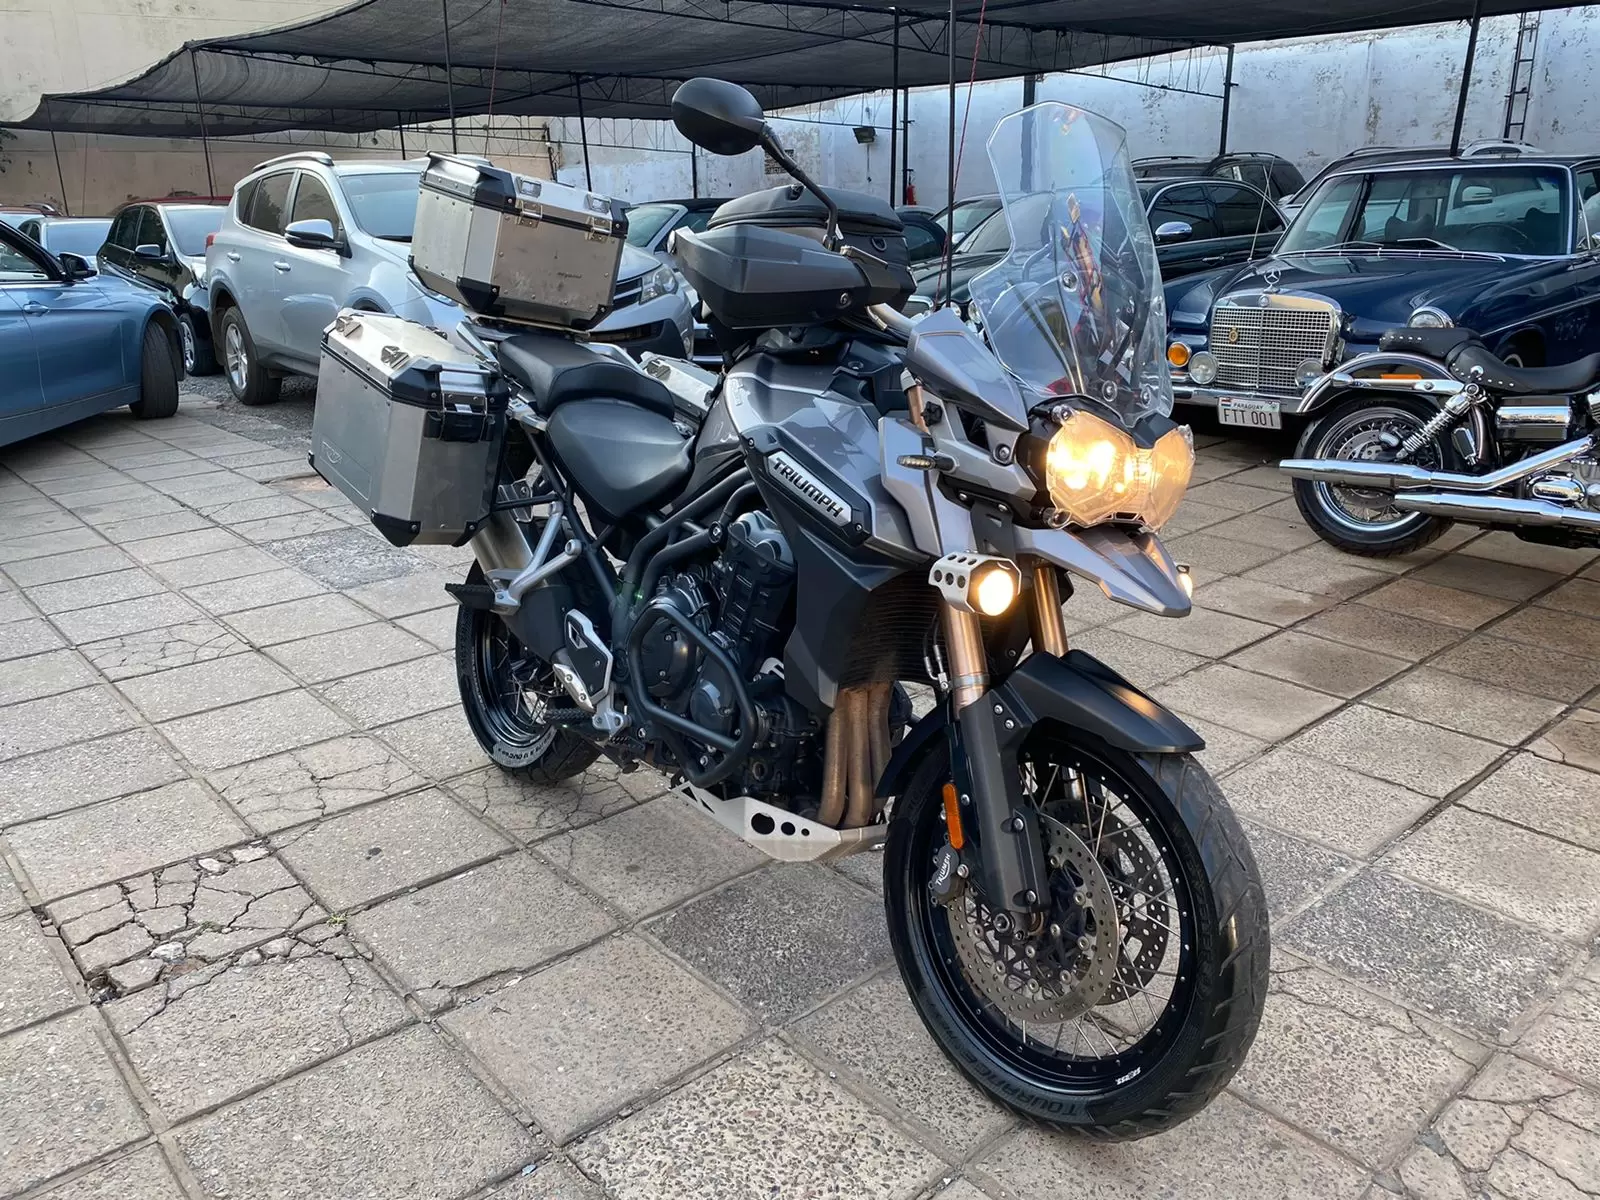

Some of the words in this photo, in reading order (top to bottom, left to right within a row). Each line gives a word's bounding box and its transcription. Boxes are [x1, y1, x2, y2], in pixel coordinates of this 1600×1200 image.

[1224, 408, 1246, 424] FTT
[1251, 410, 1274, 427] 001
[1233, 402, 1263, 410] PARAGUAY
[773, 457, 844, 518] TRIUMPH
[935, 853, 951, 886] TRIUMPH
[959, 1046, 1078, 1117] TOURANCE
